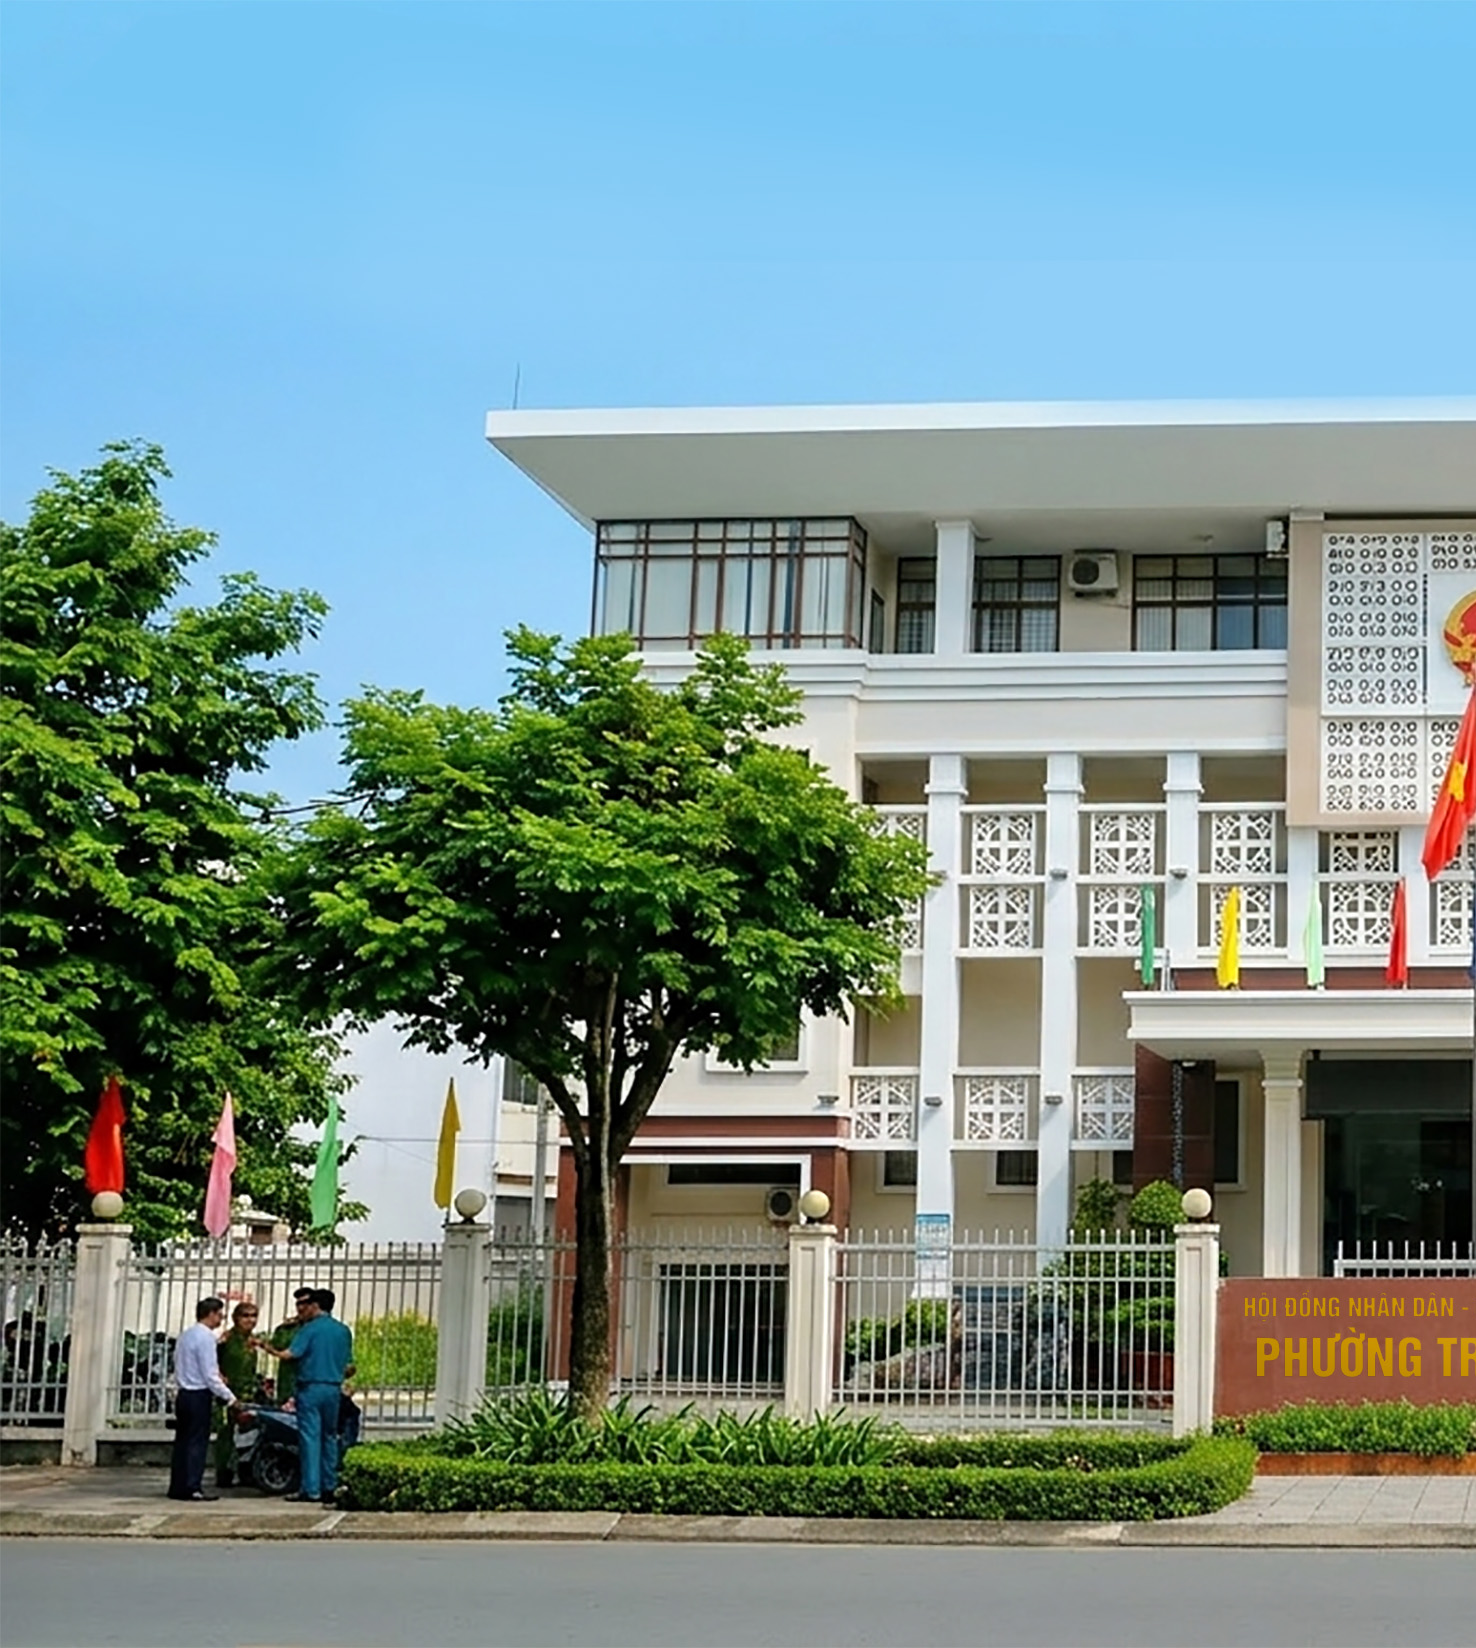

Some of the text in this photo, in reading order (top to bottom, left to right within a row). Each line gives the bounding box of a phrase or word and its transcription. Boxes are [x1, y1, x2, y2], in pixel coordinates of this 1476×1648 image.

[1244, 1292, 1277, 1322] HỘI
[1349, 1292, 1405, 1317] NHÂN
[1413, 1292, 1454, 1317] DÂN
[1256, 1327, 1422, 1377] PHƯỜNG
